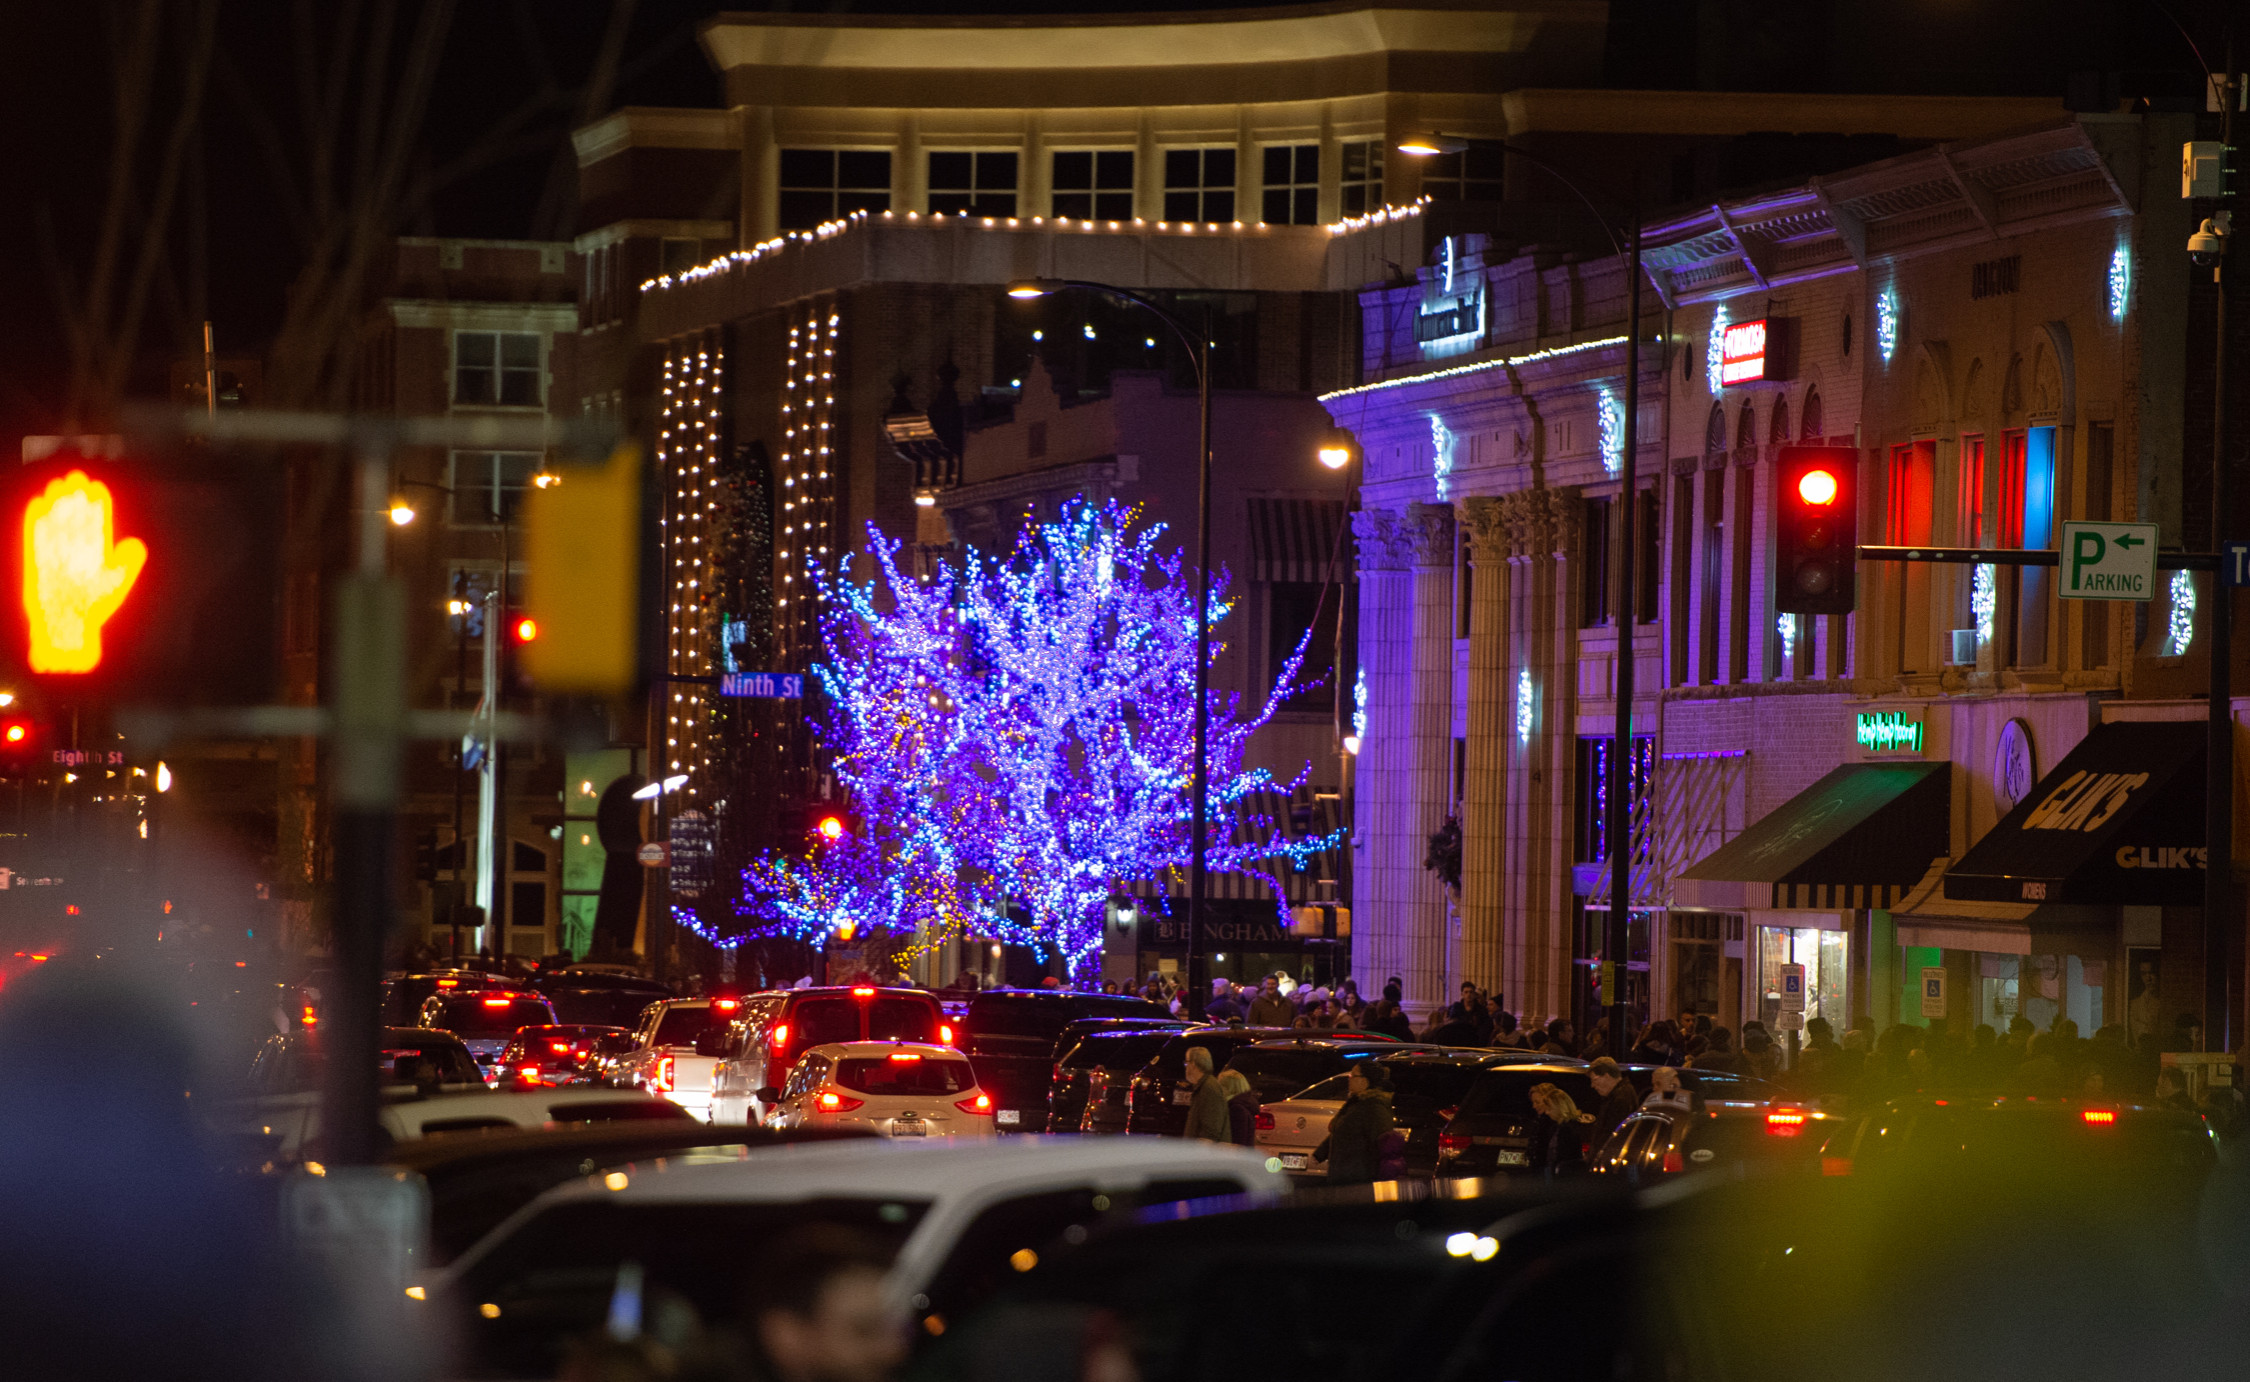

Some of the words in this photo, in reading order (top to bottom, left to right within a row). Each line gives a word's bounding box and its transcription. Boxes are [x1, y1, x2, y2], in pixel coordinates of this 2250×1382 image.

[2231, 546, 2250, 584] T
[723, 673, 774, 696] Ninth
[782, 676, 801, 697] St
[108, 751, 123, 765] St
